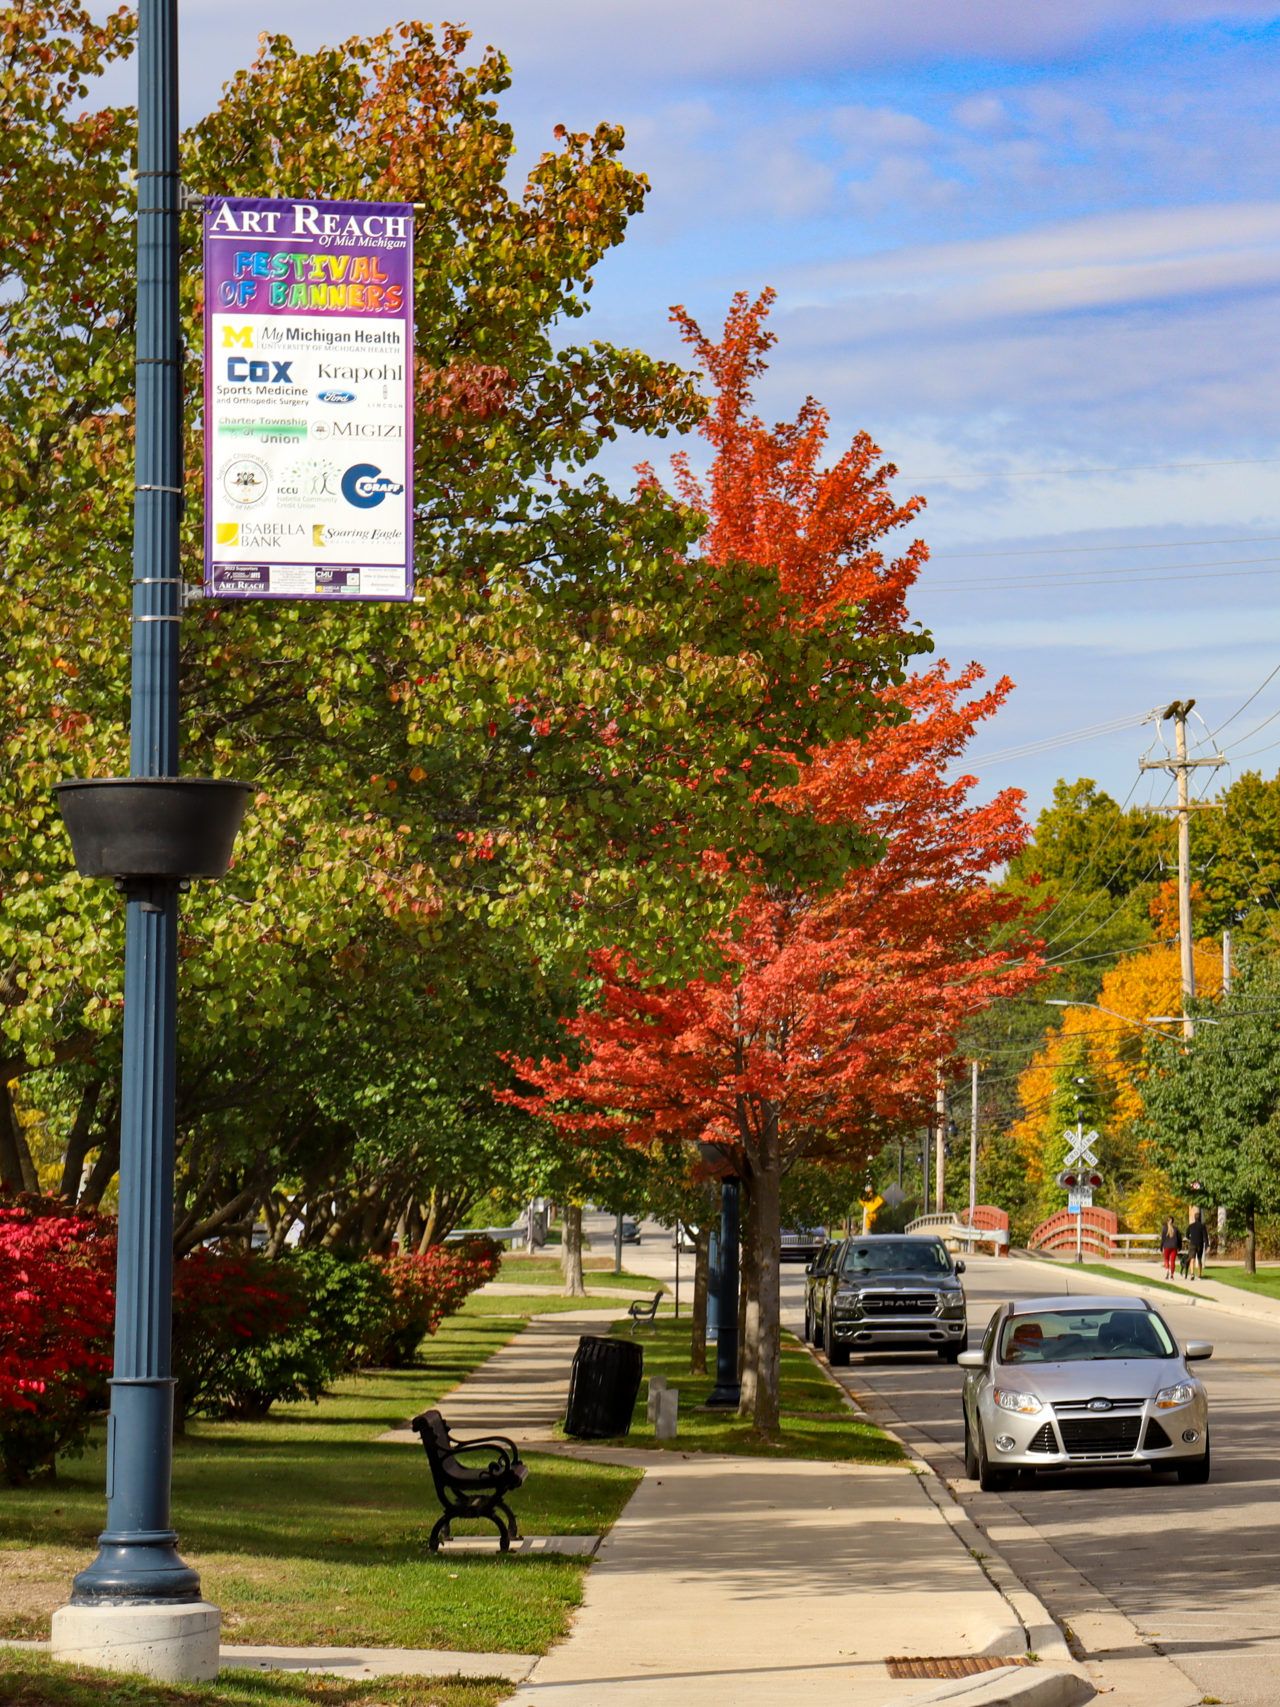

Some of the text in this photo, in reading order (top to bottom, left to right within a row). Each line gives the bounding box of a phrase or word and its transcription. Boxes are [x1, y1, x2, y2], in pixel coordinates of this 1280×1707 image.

[209, 202, 407, 238] ART REACH
[319, 235, 407, 250] Of Mid Michigan
[234, 251, 388, 283] FESTIVAL
[219, 280, 404, 313] OF BANNERS
[262, 327, 400, 345] My Michigan Health
[261, 343, 400, 354] UNIVERSITY OF MICHIGAN HEALTH
[318, 363, 402, 383] Krapohl
[217, 385, 309, 396] Sports Medicine
[323, 391, 350, 402] Ford
[217, 397, 310, 407] and Orthopedic Surgery
[218, 417, 308, 427] Charter Township
[260, 433, 300, 444] Union
[241, 522, 306, 535] ISABELLA
[324, 527, 403, 541] Soaring Eagle
[241, 536, 282, 548] BANK
